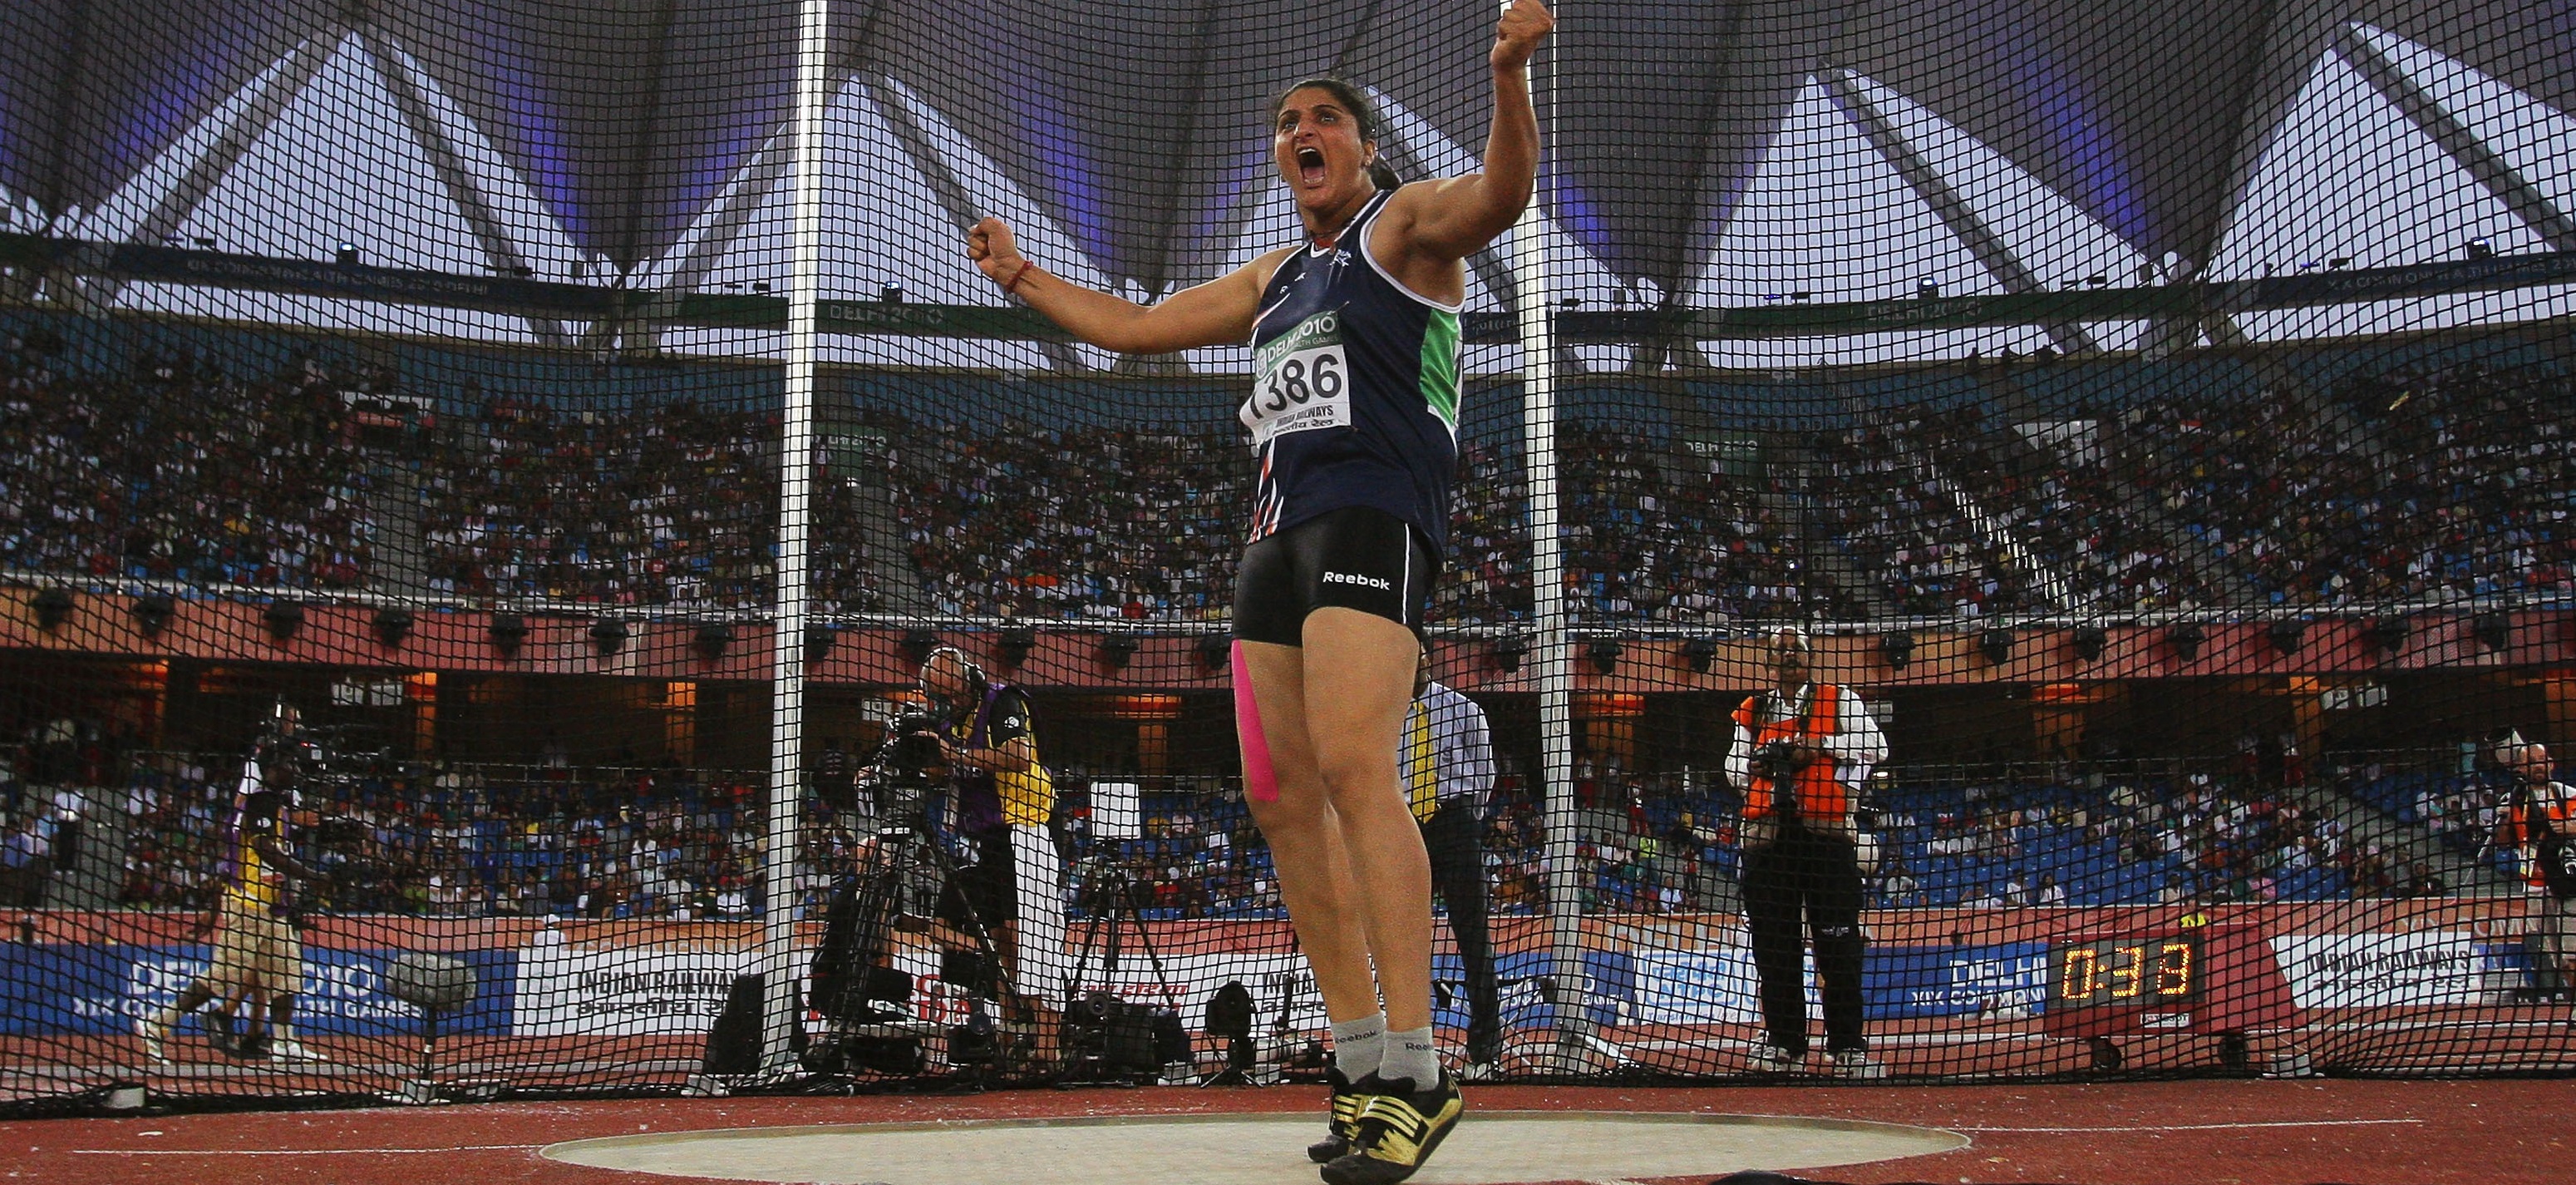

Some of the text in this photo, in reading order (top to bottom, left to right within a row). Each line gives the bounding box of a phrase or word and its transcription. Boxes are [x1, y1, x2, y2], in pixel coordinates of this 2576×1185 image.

[830, 304, 887, 323] DELHI
[1322, 571, 1390, 590] Reebok
[2309, 950, 2470, 973] INDIAN RAILWAYS
[578, 972, 648, 993] INDIAN
[1912, 990, 1945, 1006] XIX
